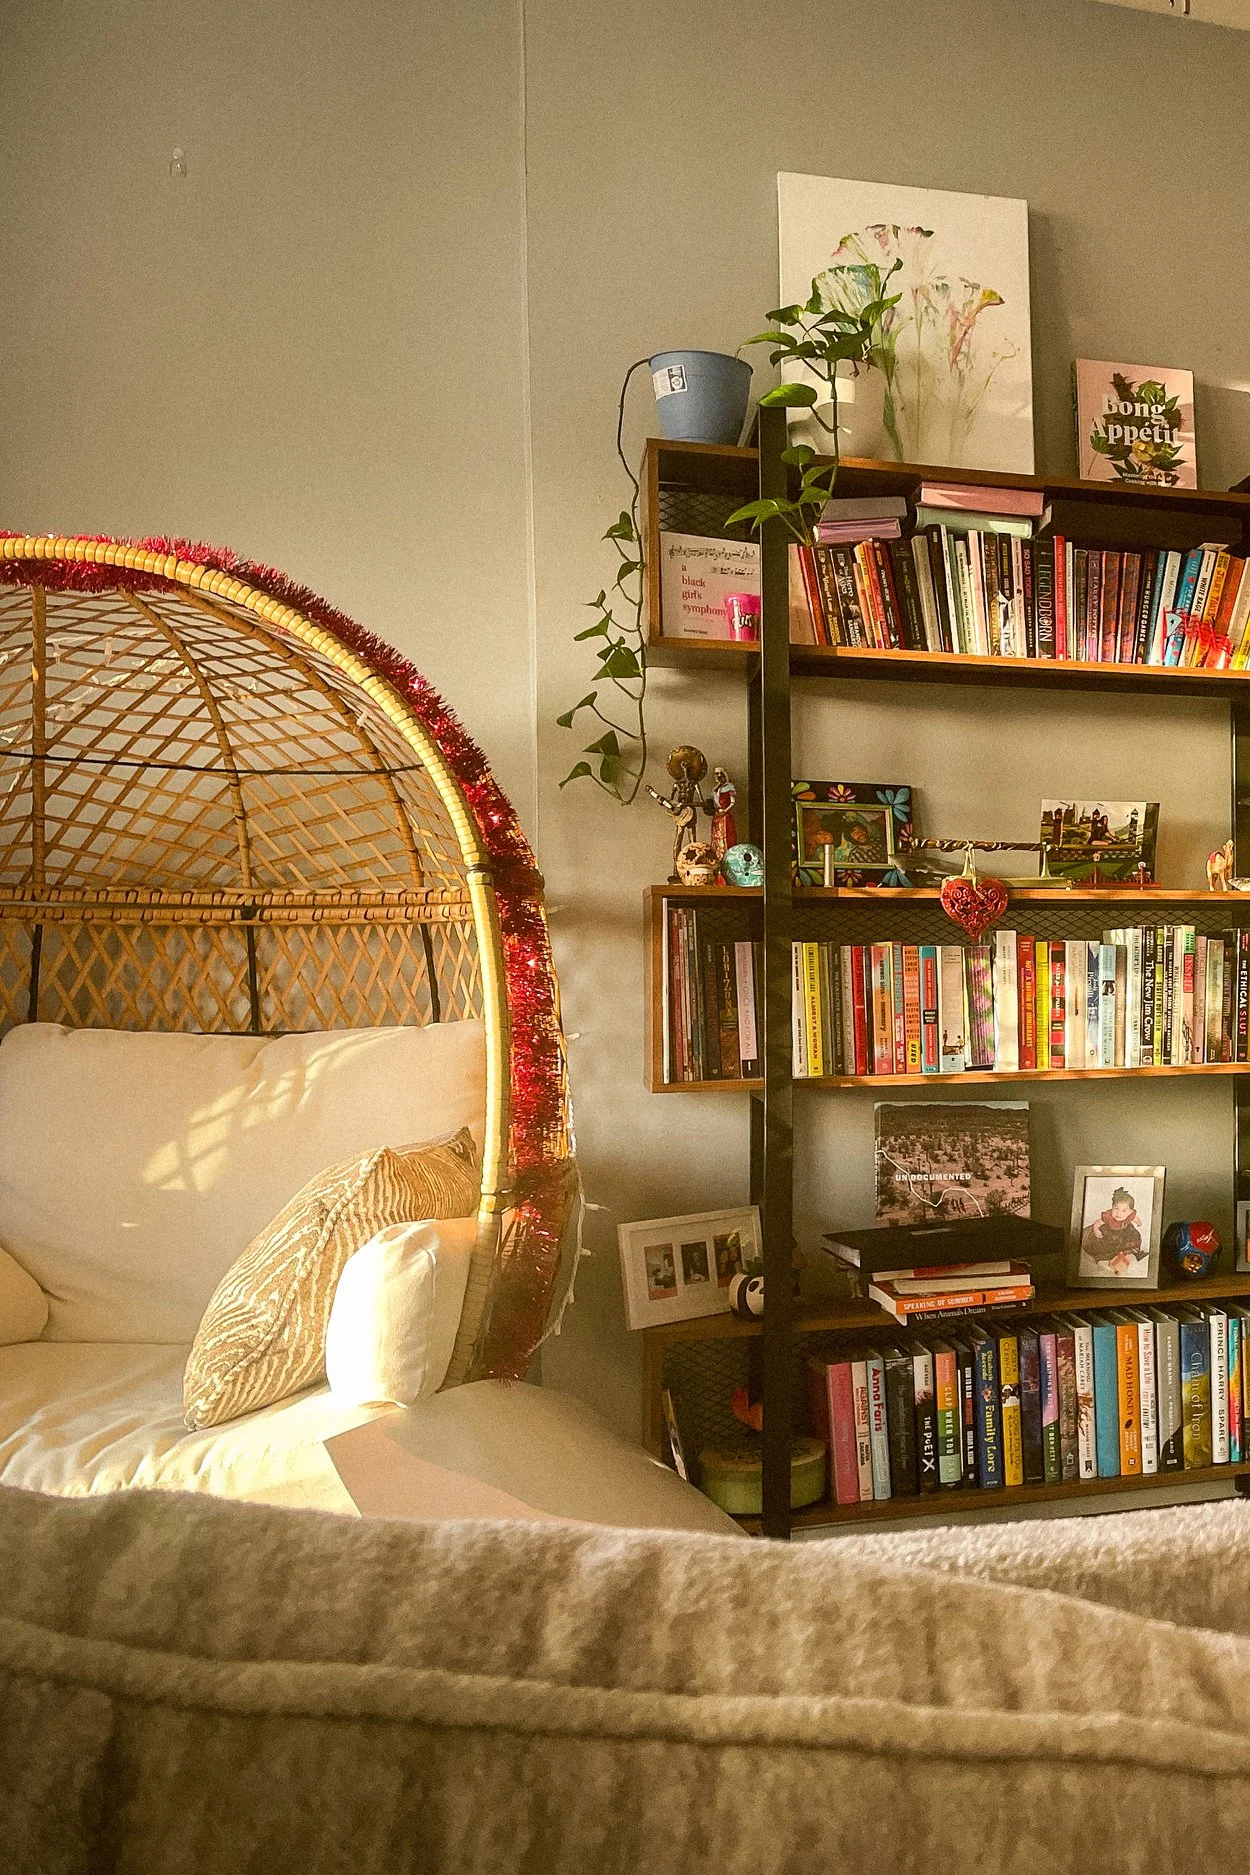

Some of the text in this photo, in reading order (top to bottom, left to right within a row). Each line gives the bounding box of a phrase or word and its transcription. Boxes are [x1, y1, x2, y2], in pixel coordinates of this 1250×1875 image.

[1102, 395, 1166, 426] Bong
[1089, 416, 1179, 446] Appétit
[1022, 548, 1030, 559] SO
[682, 564, 687, 572] a
[1023, 559, 1031, 575] SAD
[681, 576, 706, 588] black
[844, 575, 855, 597] Hero
[1197, 576, 1208, 596] WHITE
[682, 589, 703, 600] girl's
[826, 597, 834, 612] Law
[1037, 563, 1052, 642] LEGENDBORN
[1193, 595, 1203, 612] RAGE
[1206, 594, 1219, 617] TAKES
[682, 603, 727, 619] symphony
[720, 944, 733, 1017] LOBIZONA
[1239, 969, 1247, 1009] ETHICAL
[1143, 959, 1154, 1041] The New Jim Crow
[878, 1000, 887, 1032] memory
[1238, 1010, 1247, 1035] SLUT
[903, 1301, 935, 1310] SPEAKING
[947, 1296, 974, 1304] SUMMER
[915, 1307, 986, 1321] When Animals Dream
[1142, 1328, 1150, 1343] How
[1216, 1321, 1224, 1361] PRINCE
[1077, 1342, 1085, 1369] MARIAH
[1142, 1351, 1151, 1366] Save
[1078, 1369, 1086, 1391] CAREY
[1123, 1356, 1134, 1417] MAD HONEY
[1143, 1372, 1151, 1384] Life
[858, 1385, 868, 1425] AGAINST
[870, 1367, 885, 1432] Anna Faris
[1189, 1351, 1204, 1441] Chain of Iron
[944, 1385, 954, 1454] CLAP WHEN YOU
[1217, 1408, 1225, 1443] SPARE
[981, 1404, 998, 1473] Family Lore
[921, 1457, 935, 1472] X
